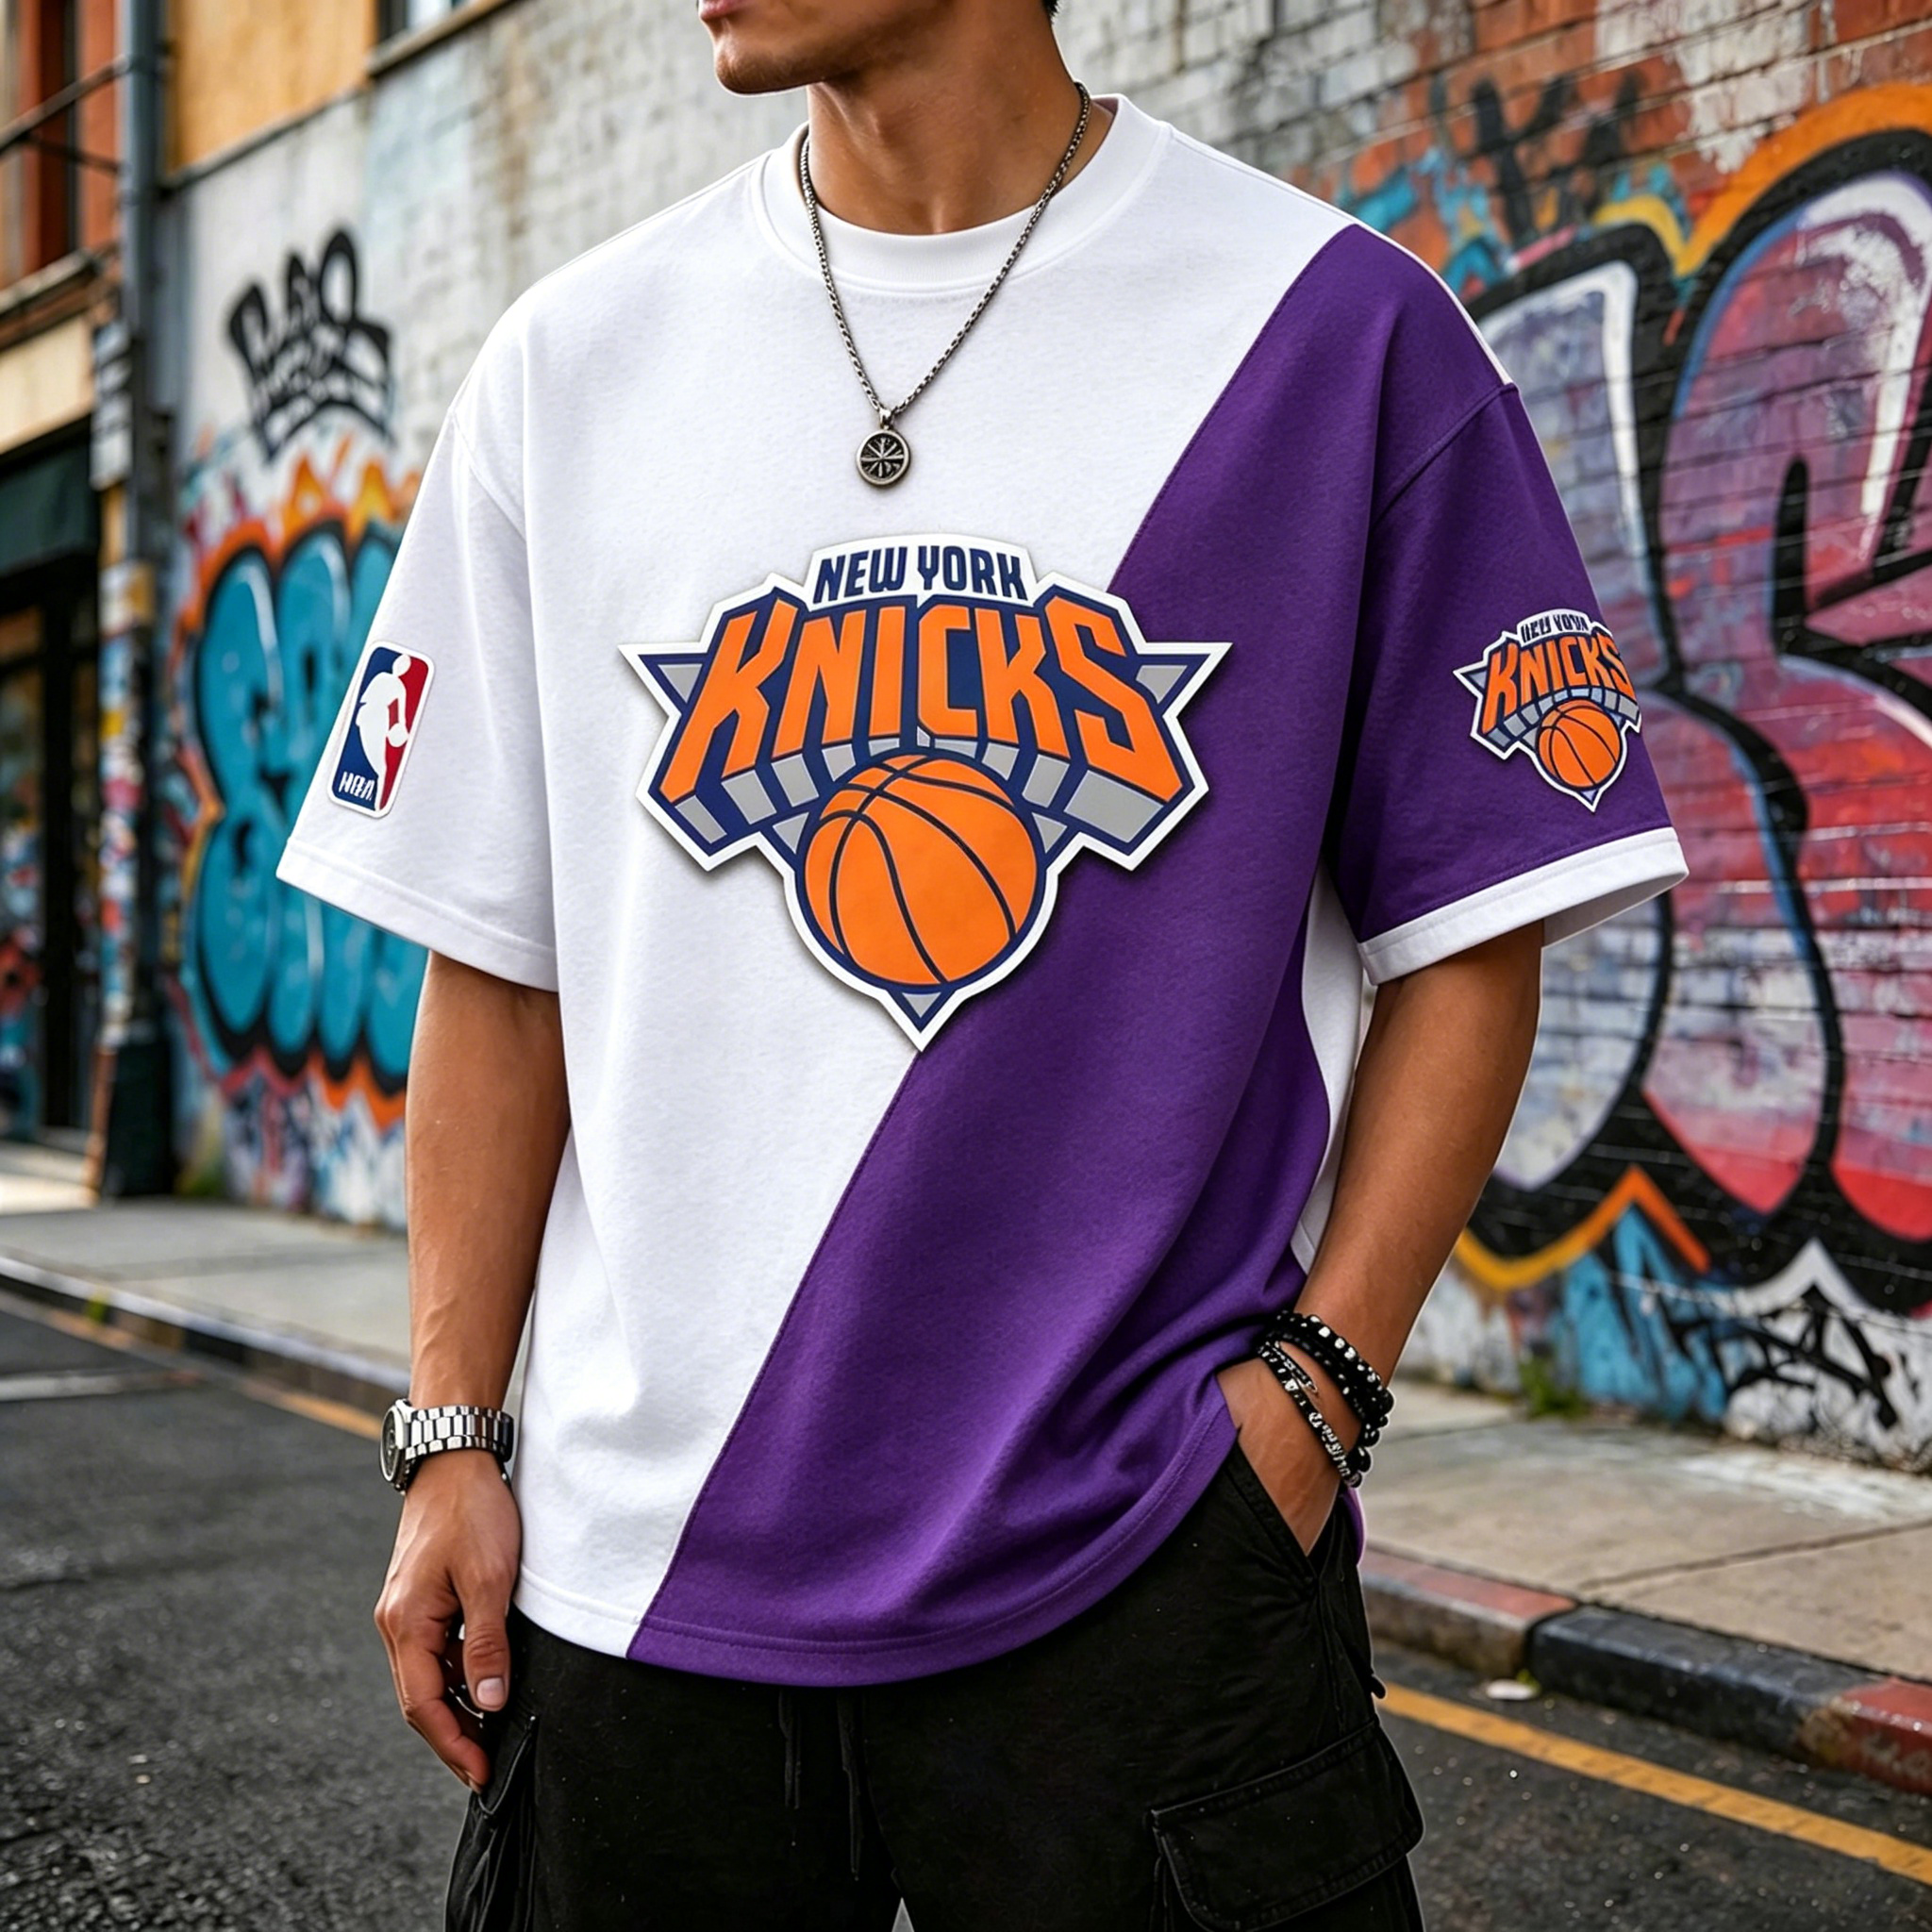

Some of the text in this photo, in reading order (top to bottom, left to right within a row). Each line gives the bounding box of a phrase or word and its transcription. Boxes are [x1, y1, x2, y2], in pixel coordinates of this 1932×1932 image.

[812, 545, 1028, 604] NEW YORK
[659, 595, 1184, 805] KNICKS
[1481, 631, 1638, 734] KNICKS
